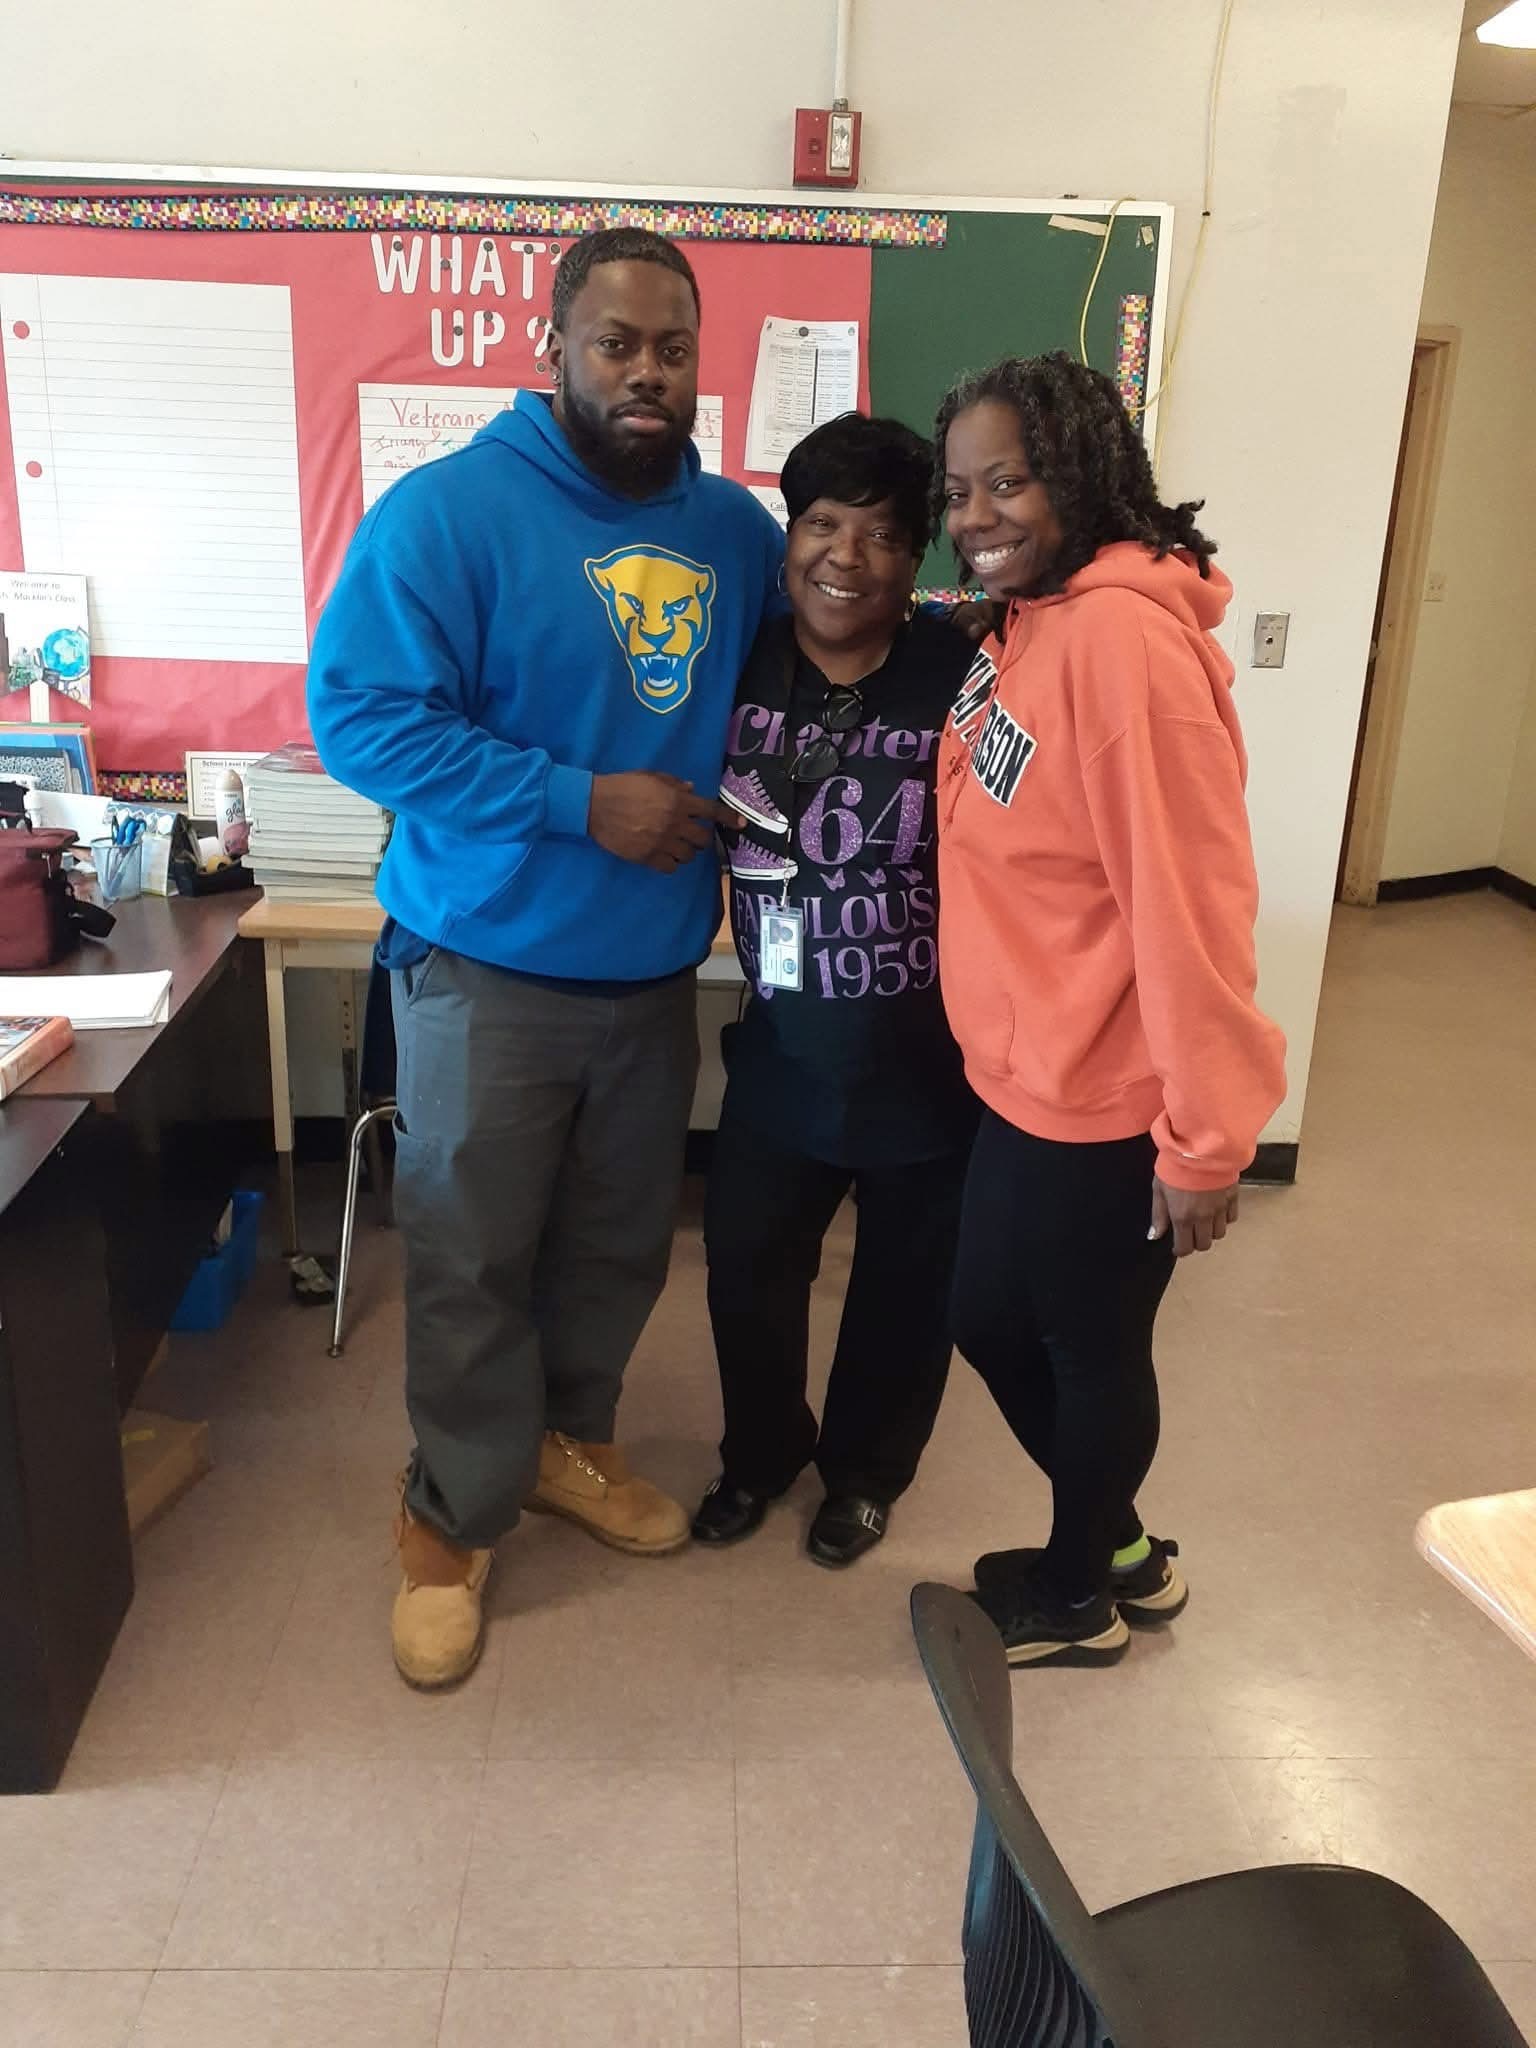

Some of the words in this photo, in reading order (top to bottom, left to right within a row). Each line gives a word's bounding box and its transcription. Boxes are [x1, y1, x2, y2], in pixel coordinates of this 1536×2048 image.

[431, 308, 505, 368] UP
[389, 397, 488, 429] Veterans
[727, 703, 942, 762] Chapter
[799, 775, 933, 865] 64
[813, 936, 938, 999] 1959
